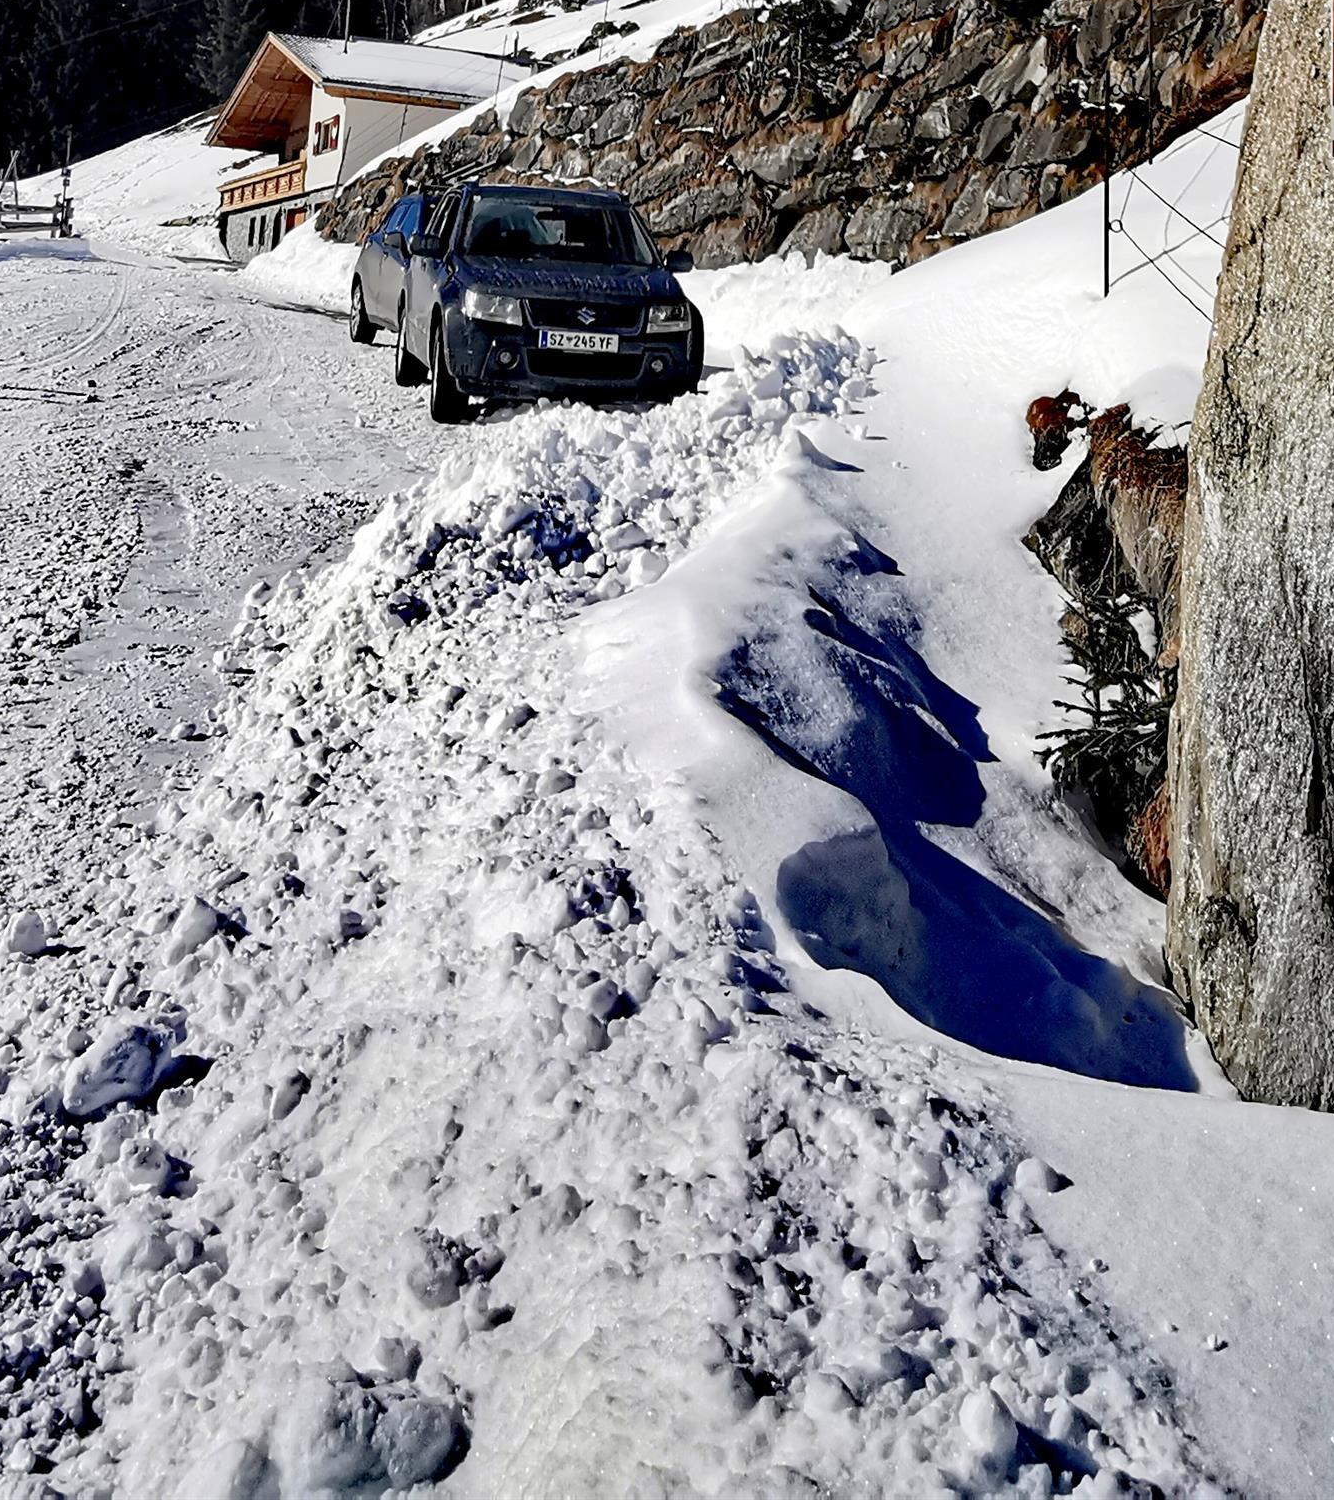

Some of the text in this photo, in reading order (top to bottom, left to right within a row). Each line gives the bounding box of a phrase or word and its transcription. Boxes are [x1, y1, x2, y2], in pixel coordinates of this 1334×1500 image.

[549, 333, 614, 349] SZ 245 YF
